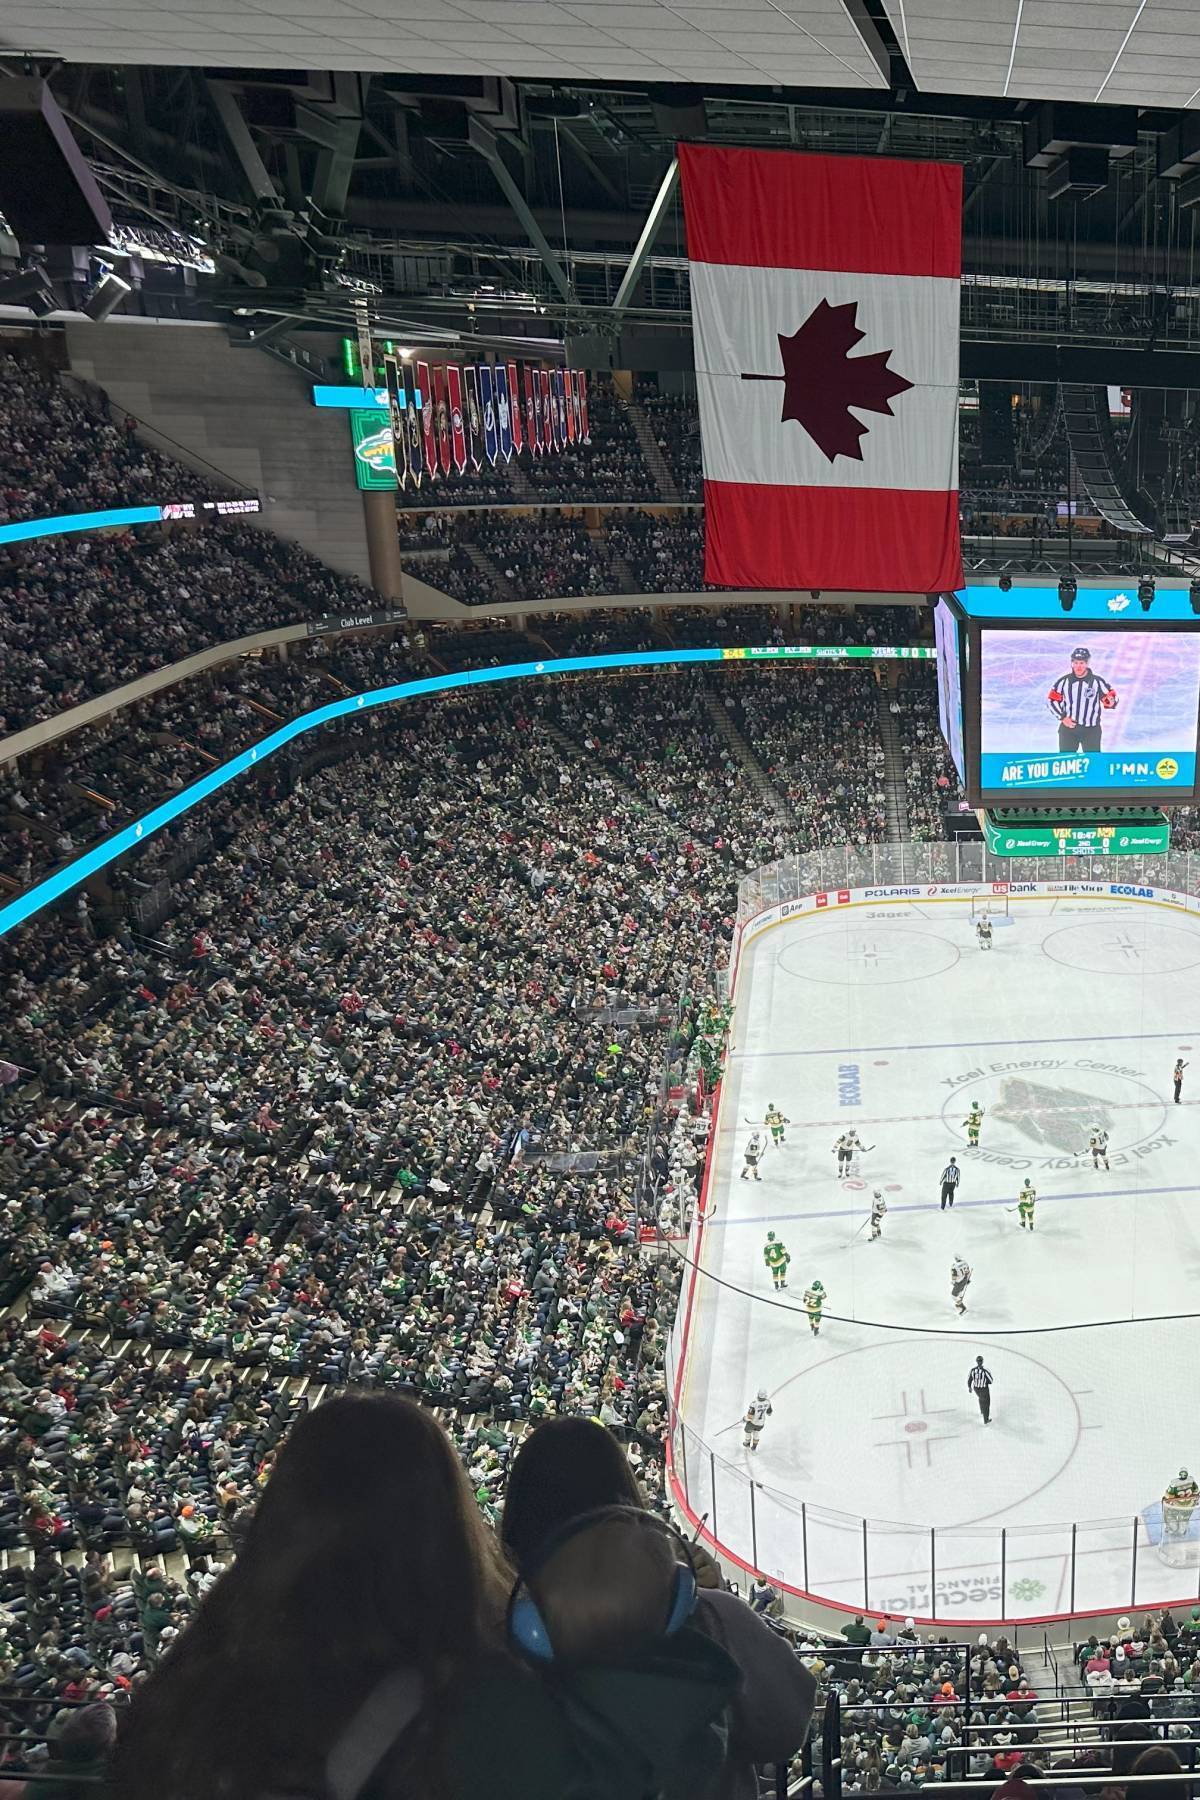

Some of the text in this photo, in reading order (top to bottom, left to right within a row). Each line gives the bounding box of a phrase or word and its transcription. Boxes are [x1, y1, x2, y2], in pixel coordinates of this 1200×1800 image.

[341, 617, 355, 628] Club
[355, 615, 373, 625] Level
[1002, 757, 1090, 782] ARE YOU GAME?
[865, 887, 920, 898] POLARIS
[1010, 883, 1037, 892] bank
[1110, 885, 1154, 898] ECOLAB
[940, 1058, 1147, 1089] Xcel Energy Center
[838, 1065, 861, 1106] ECOLAB
[1131, 1134, 1179, 1164] Xcel
[1039, 1151, 1130, 1170] Eergy
[906, 1575, 1000, 1593] FINANCAL
